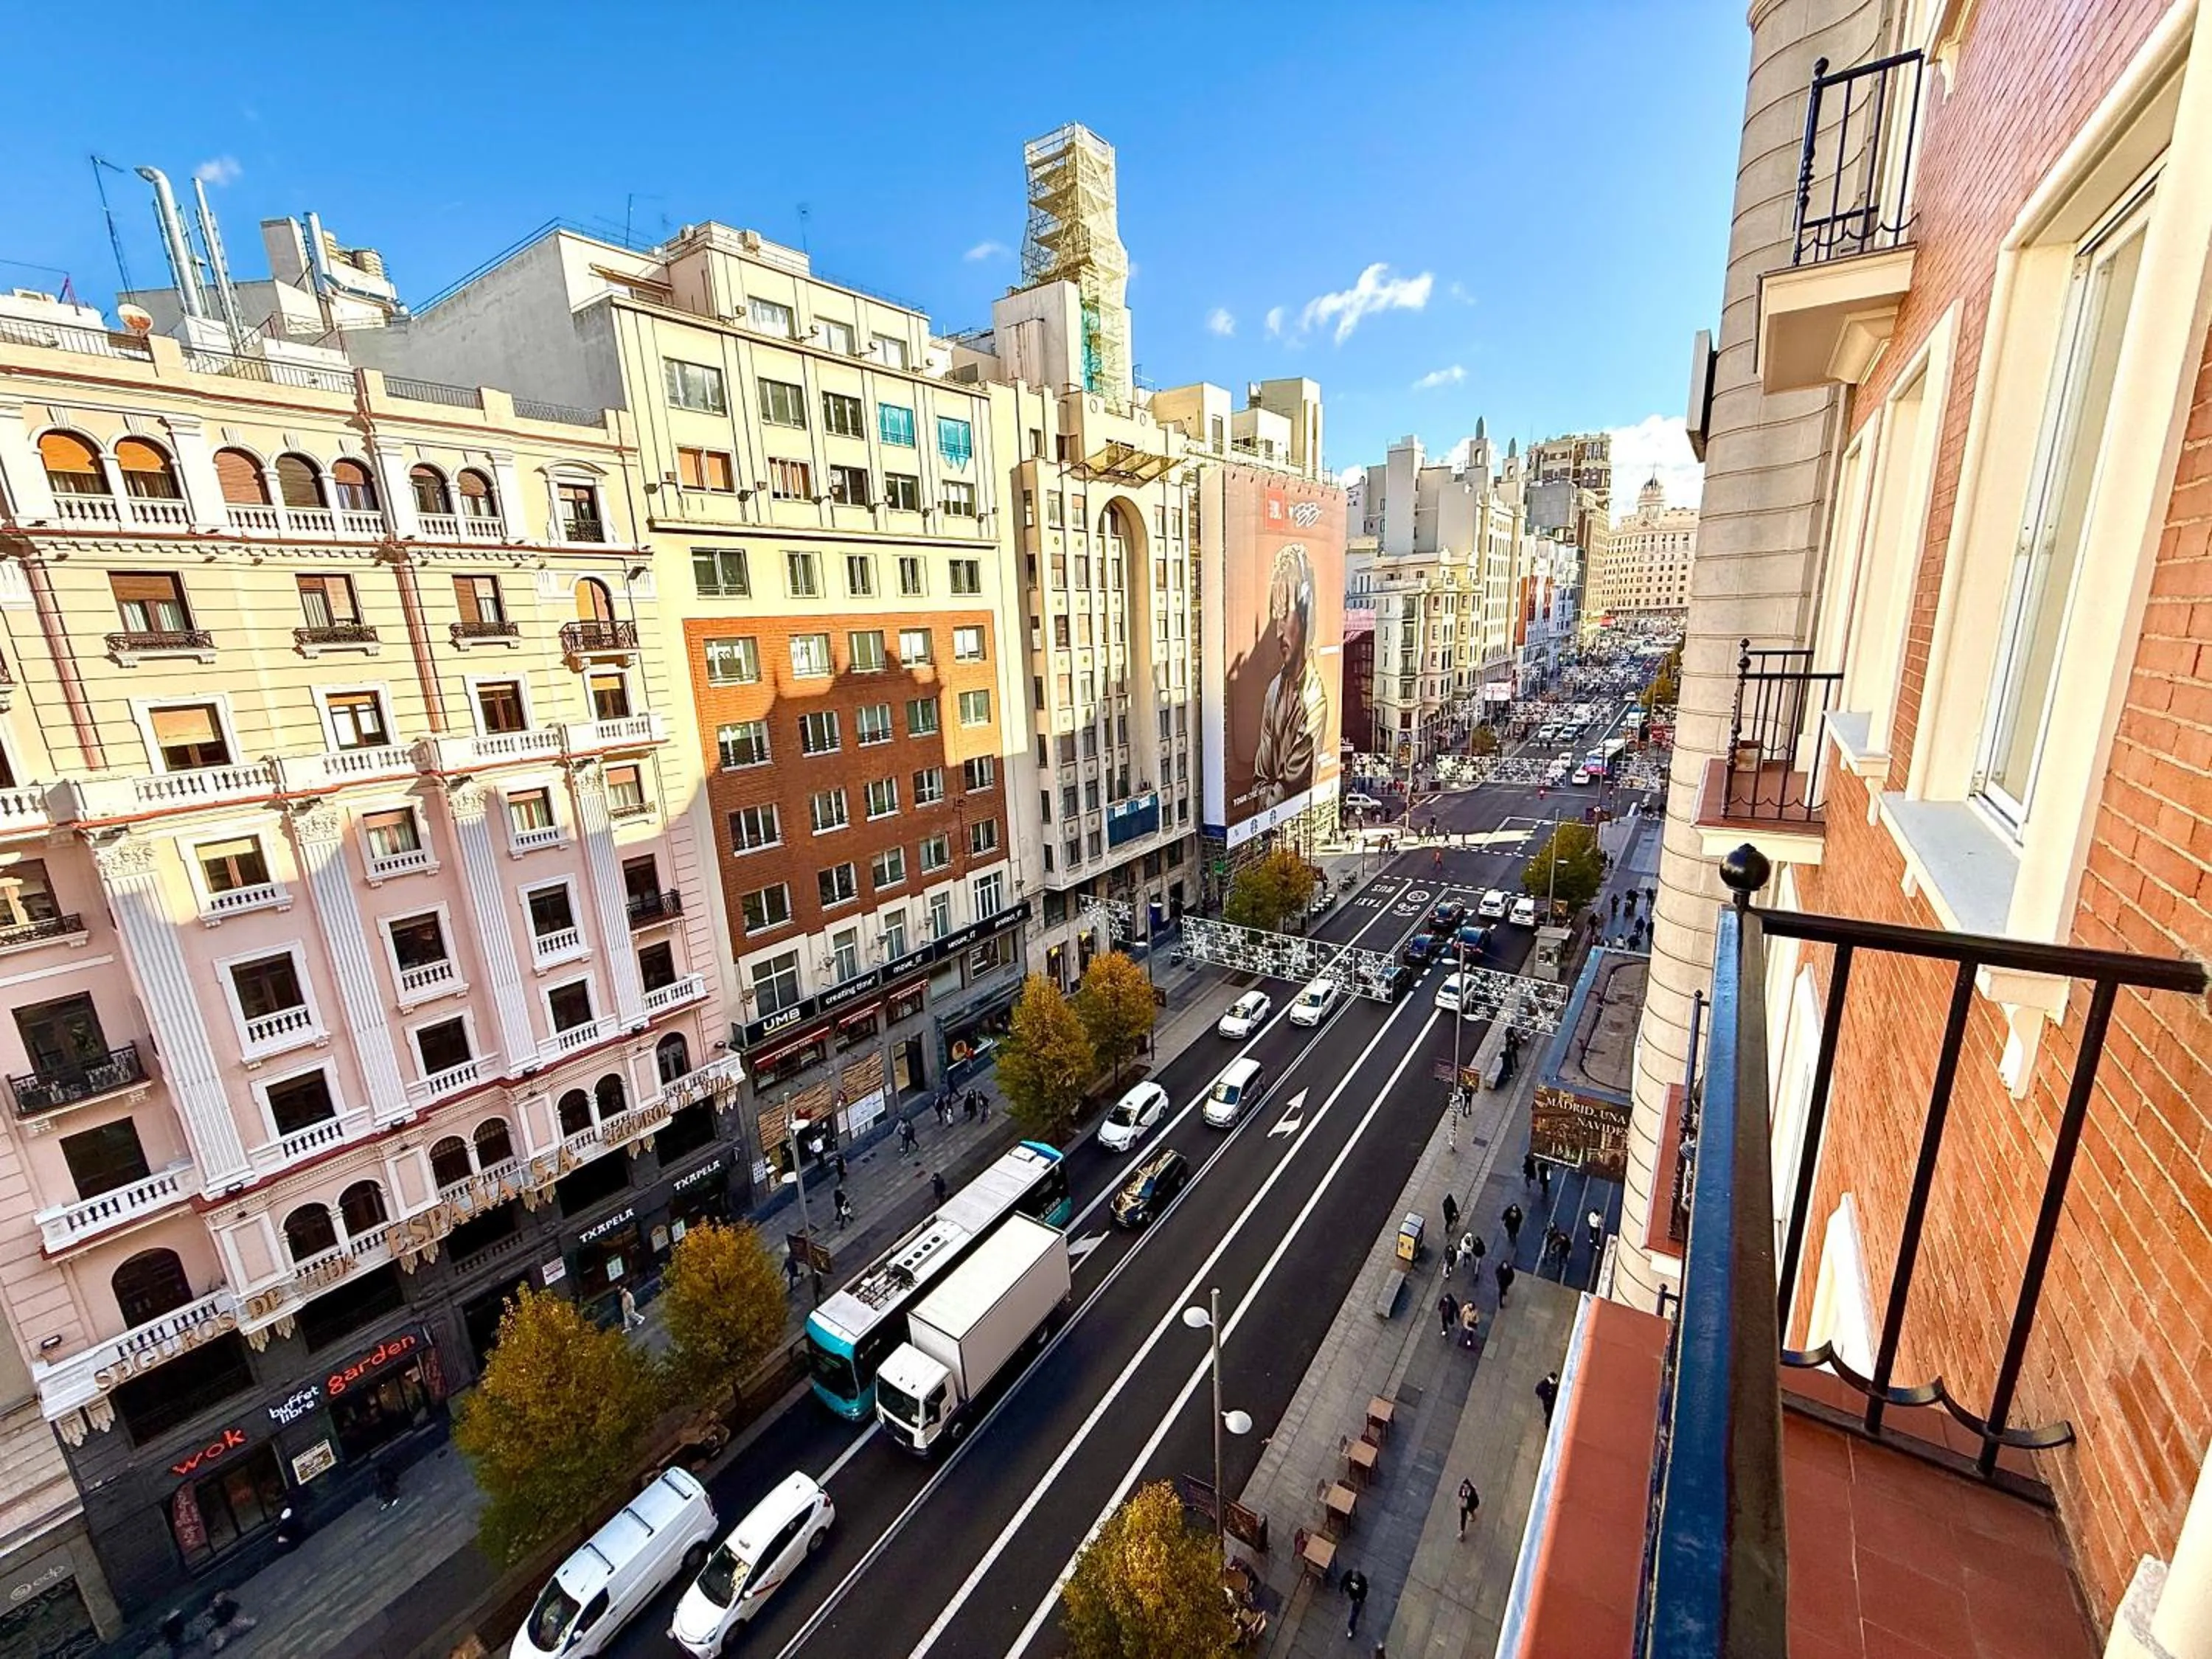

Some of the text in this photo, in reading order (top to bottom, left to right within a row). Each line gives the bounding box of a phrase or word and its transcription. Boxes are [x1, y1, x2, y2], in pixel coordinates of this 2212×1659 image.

[1354, 897, 1384, 908] TAXI
[1371, 884, 1396, 893] BUS
[825, 986, 855, 1004] creating
[762, 1008, 800, 1031] UMB
[1547, 1096, 1626, 1125] MADRID. UNA
[672, 1159, 721, 1192] TXAPELA
[94, 1310, 237, 1390] SEGUROS
[247, 1286, 284, 1318] DE
[387, 1175, 518, 1253] ESPAÑA
[677, 1090, 697, 1110] DE
[579, 1207, 635, 1244] TXAPELA
[327, 1334, 417, 1397] garden
[268, 1385, 320, 1419] buffet
[277, 1400, 316, 1425] libre
[171, 1427, 247, 1476] wok
